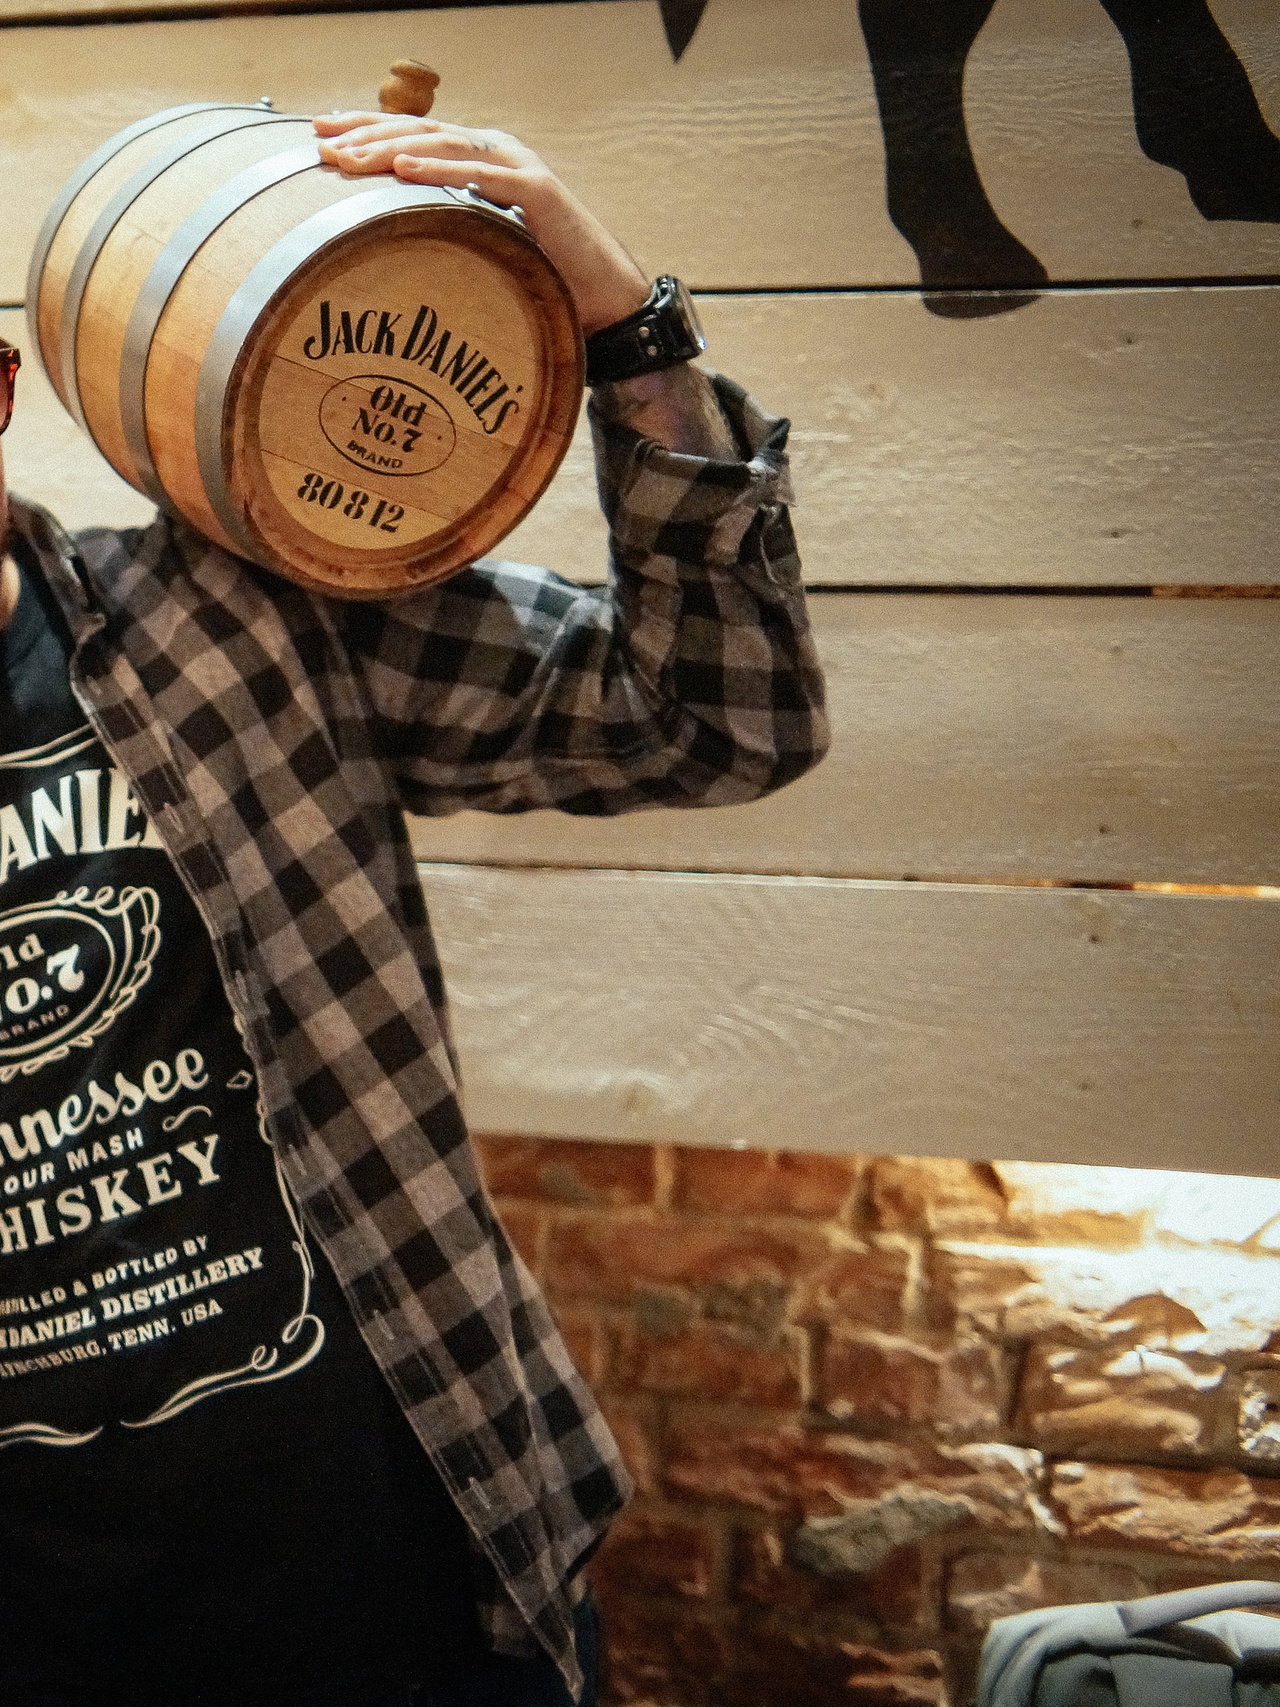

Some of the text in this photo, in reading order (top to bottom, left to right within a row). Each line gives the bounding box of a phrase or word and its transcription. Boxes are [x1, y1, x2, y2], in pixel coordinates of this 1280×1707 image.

[303, 300, 524, 435] JACK DANIEL'S
[370, 384, 428, 427] Old
[346, 439, 404, 469] BRAND
[66, 1127, 144, 1173] MASH
[91, 1246, 178, 1291] BOTTLED
[182, 1234, 208, 1257] BY
[99, 1246, 264, 1321] DISTILLERY
[180, 1298, 223, 1327] USA
